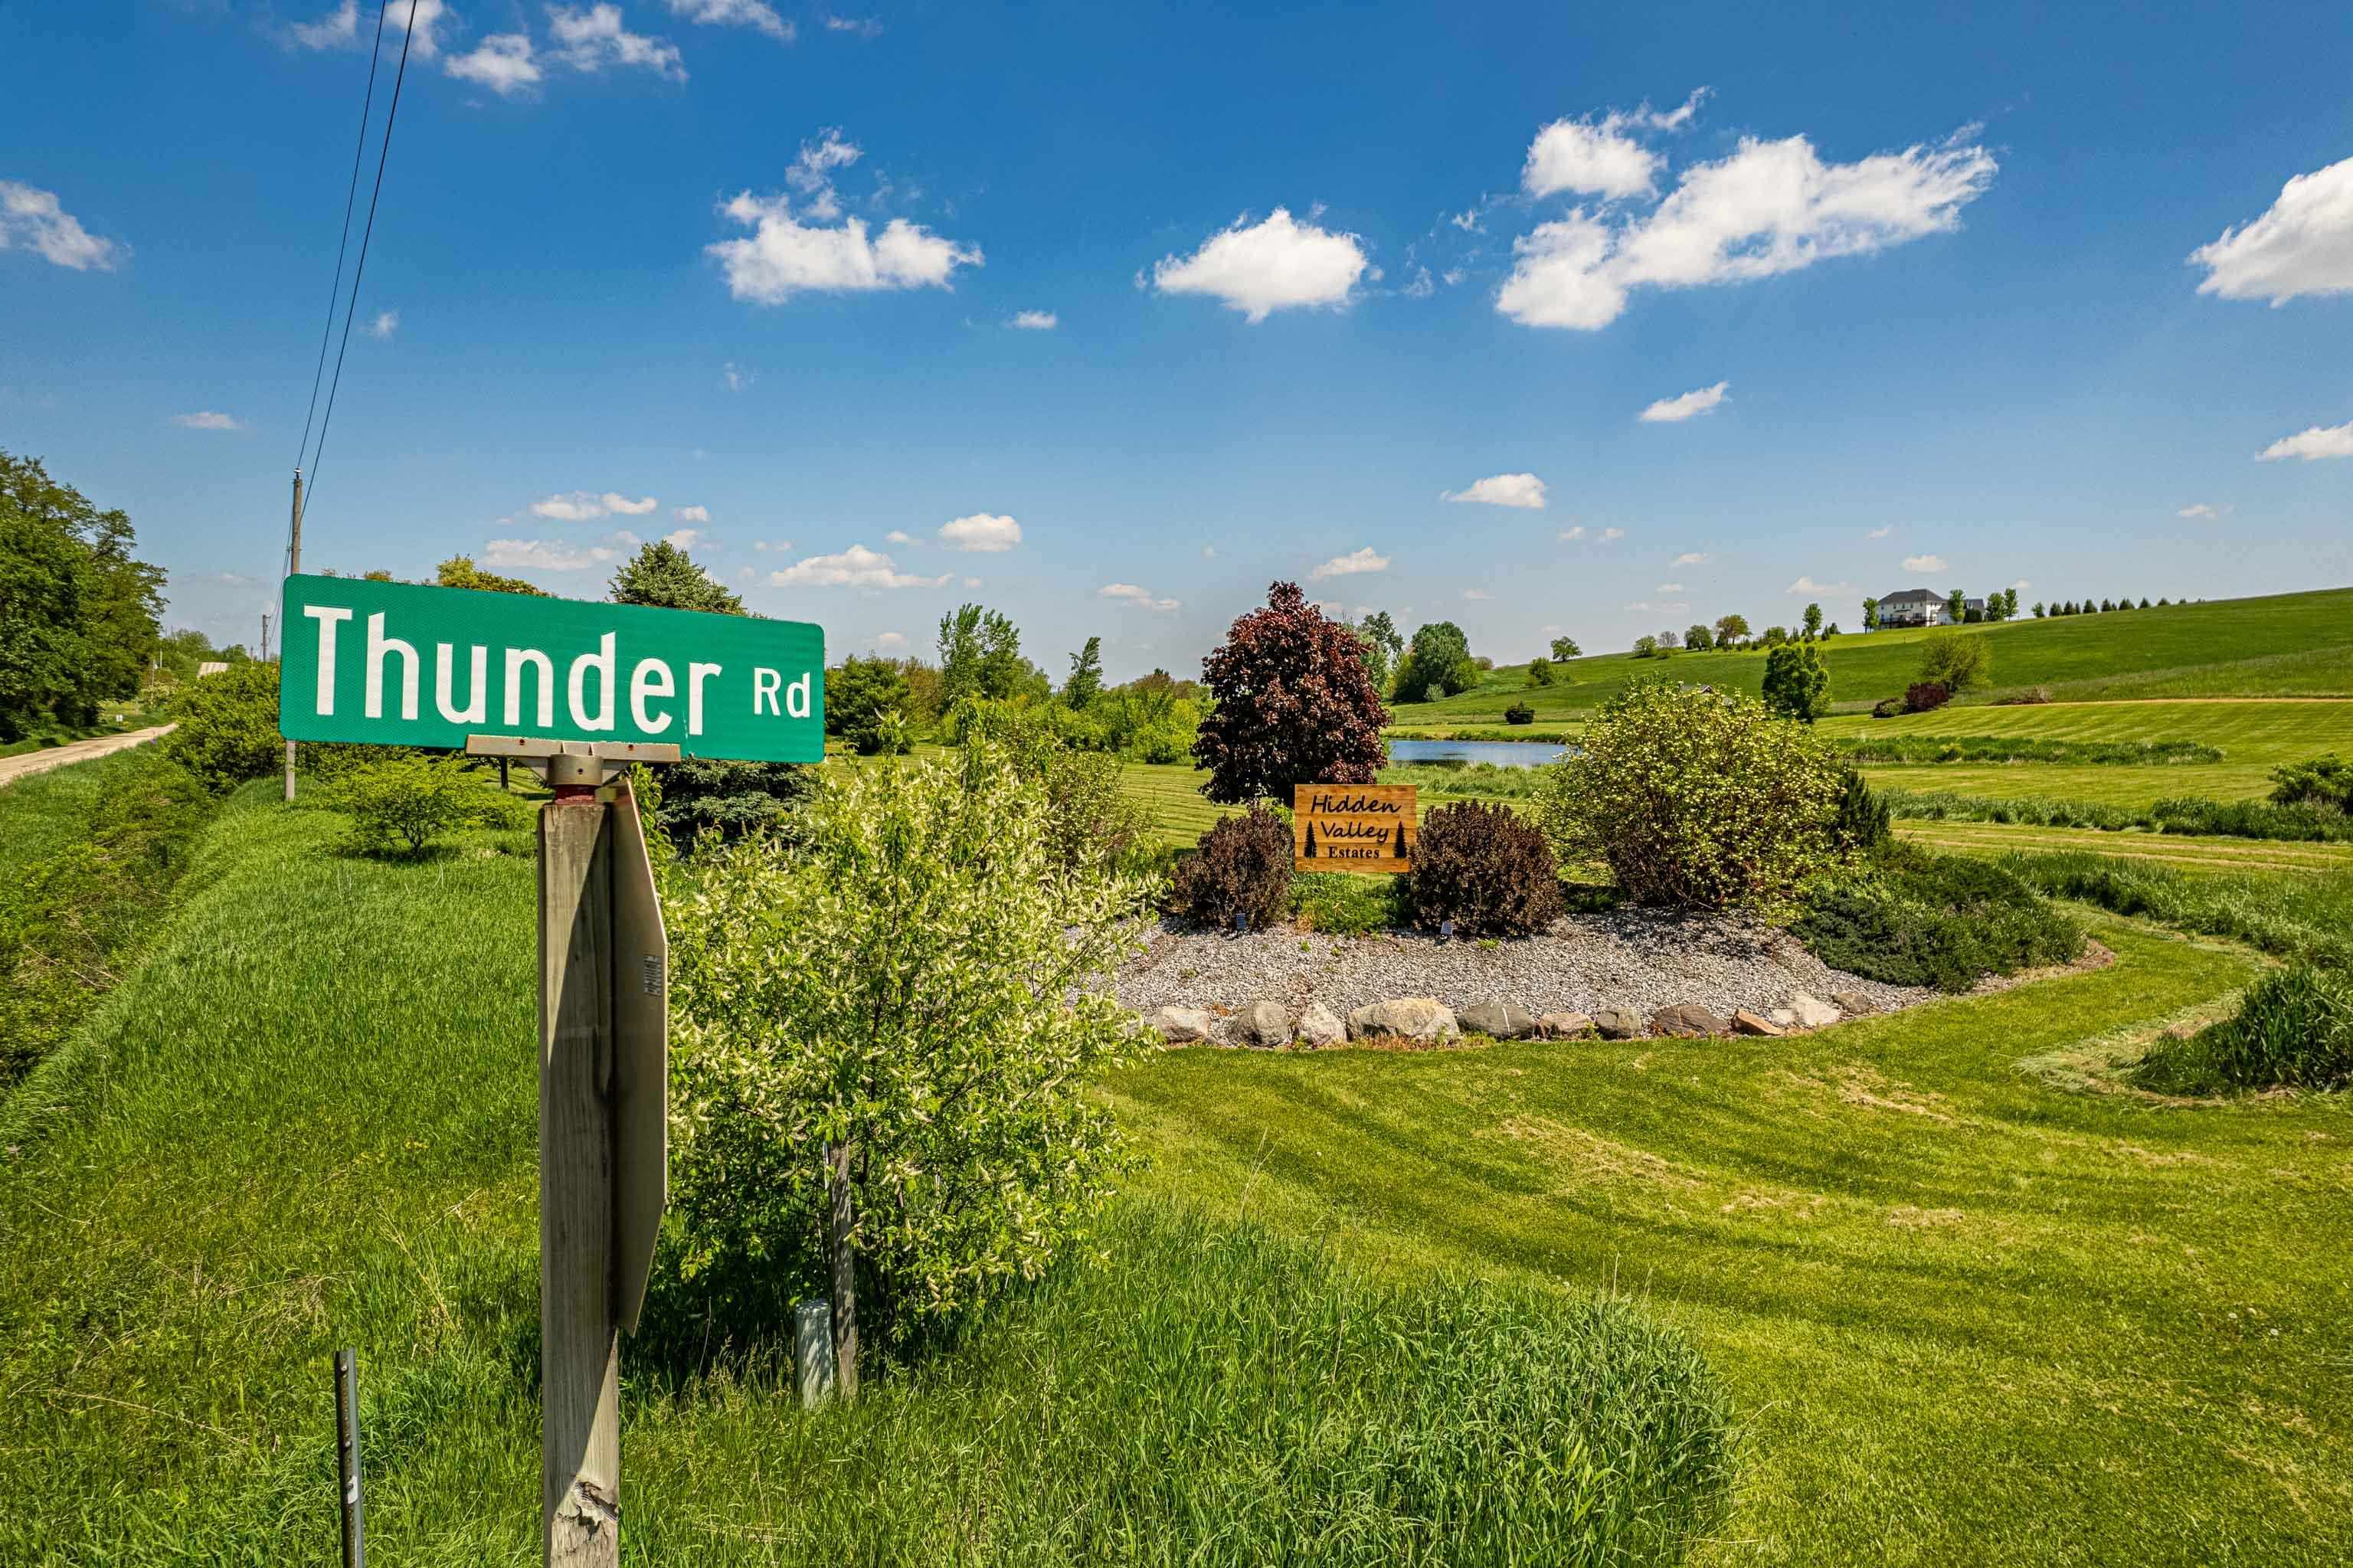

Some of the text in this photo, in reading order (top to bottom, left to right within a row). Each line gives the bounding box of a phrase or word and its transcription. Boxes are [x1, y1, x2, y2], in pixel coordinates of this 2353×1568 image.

[303, 604, 810, 735] Thunder Rd
[1311, 794, 1402, 813] Hidden
[1320, 820, 1389, 843] Valley
[1328, 846, 1379, 859] Estates
